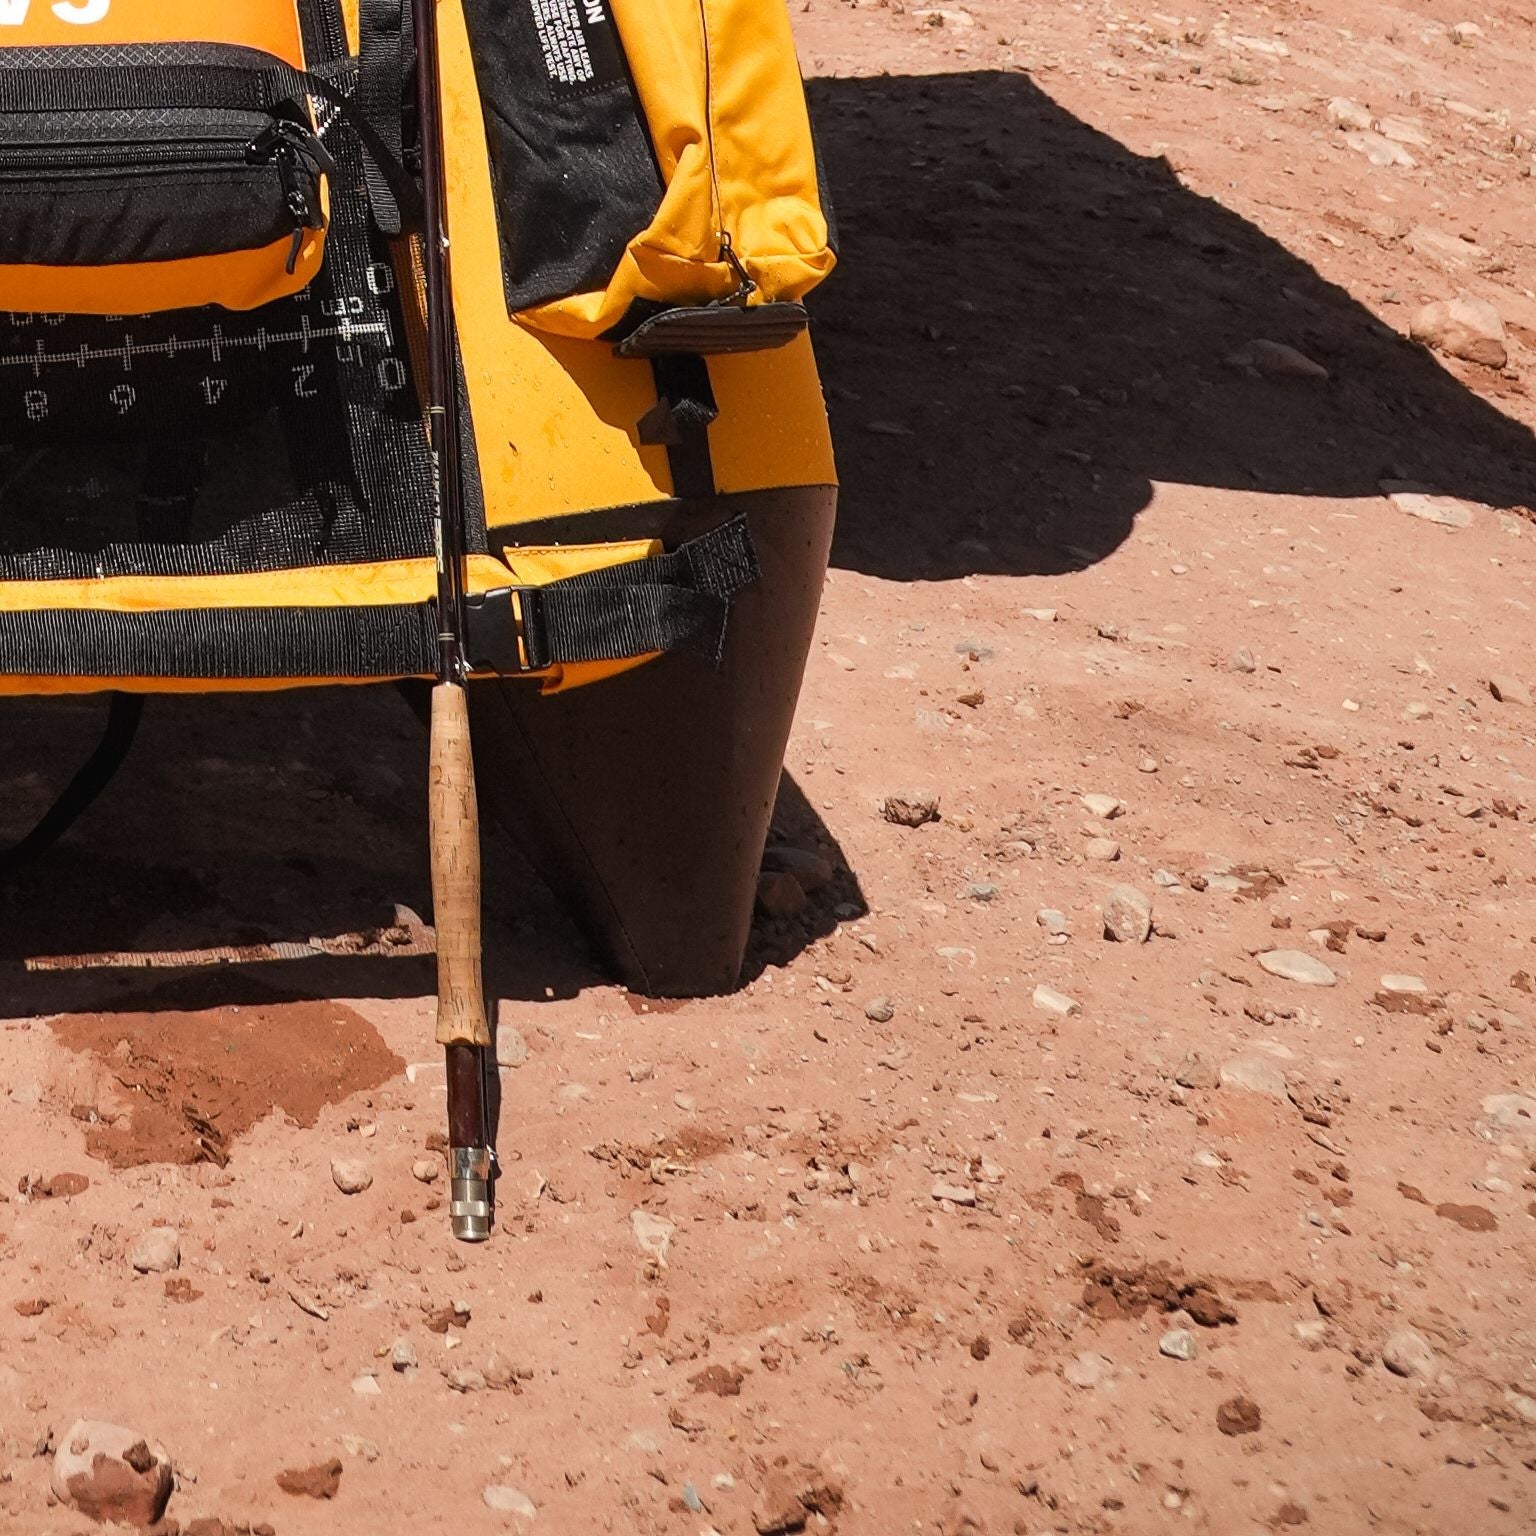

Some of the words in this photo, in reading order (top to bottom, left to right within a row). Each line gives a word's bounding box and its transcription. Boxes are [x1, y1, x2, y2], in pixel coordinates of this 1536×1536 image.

[548, 0, 561, 20] USE
[568, 8, 581, 29] FOR
[538, 29, 551, 52] LIFE
[553, 19, 566, 40] FOR
[573, 29, 586, 47] AIR
[545, 24, 563, 62] ALWAYS
[556, 61, 569, 83] USE
[570, 48, 583, 68] ANY
[578, 46, 594, 79] LEAKS
[575, 68, 587, 82] OF
[366, 262, 395, 295] 0
[291, 364, 317, 398] 2
[377, 357, 406, 390] 0
[109, 384, 136, 415] 6
[199, 376, 228, 405] 4
[24, 389, 49, 422] 8
